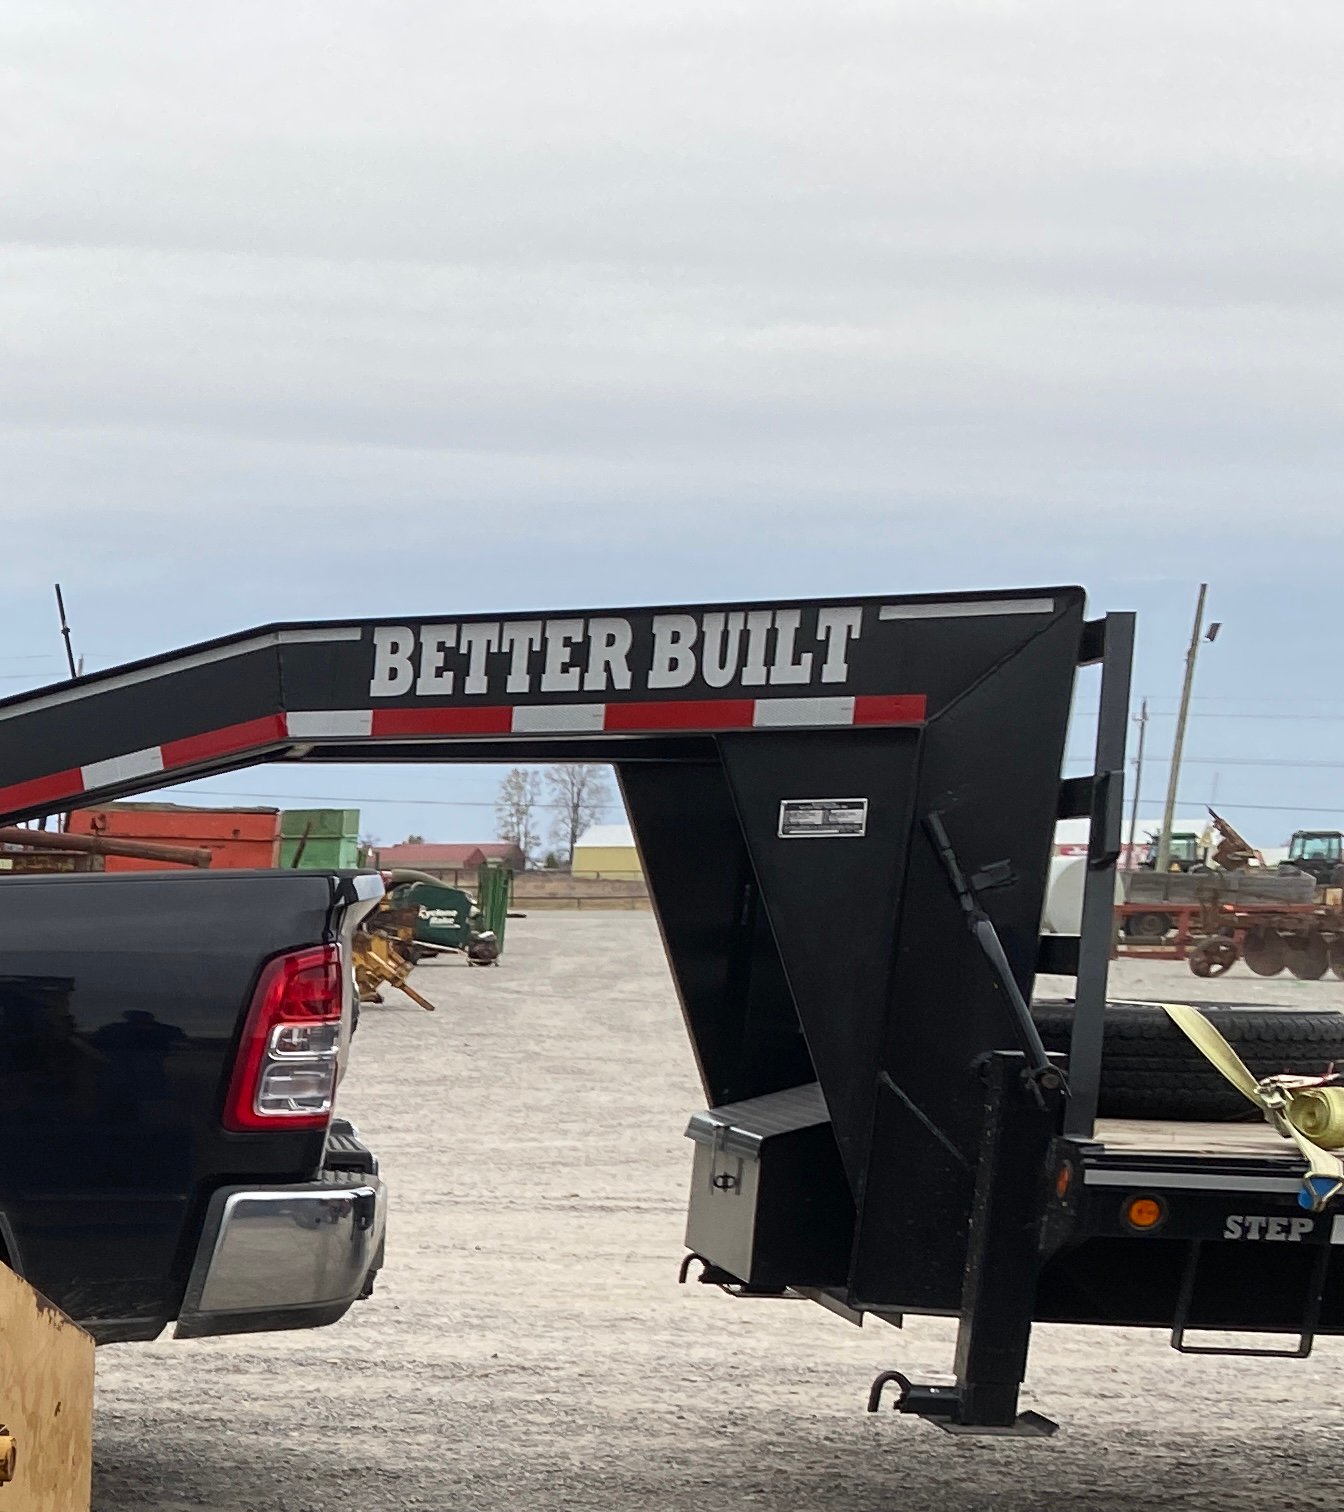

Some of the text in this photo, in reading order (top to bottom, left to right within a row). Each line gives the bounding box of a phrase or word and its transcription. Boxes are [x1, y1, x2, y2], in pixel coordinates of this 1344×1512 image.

[369, 606, 863, 698] BETTER BUILT
[1223, 1214, 1315, 1242] STEP
